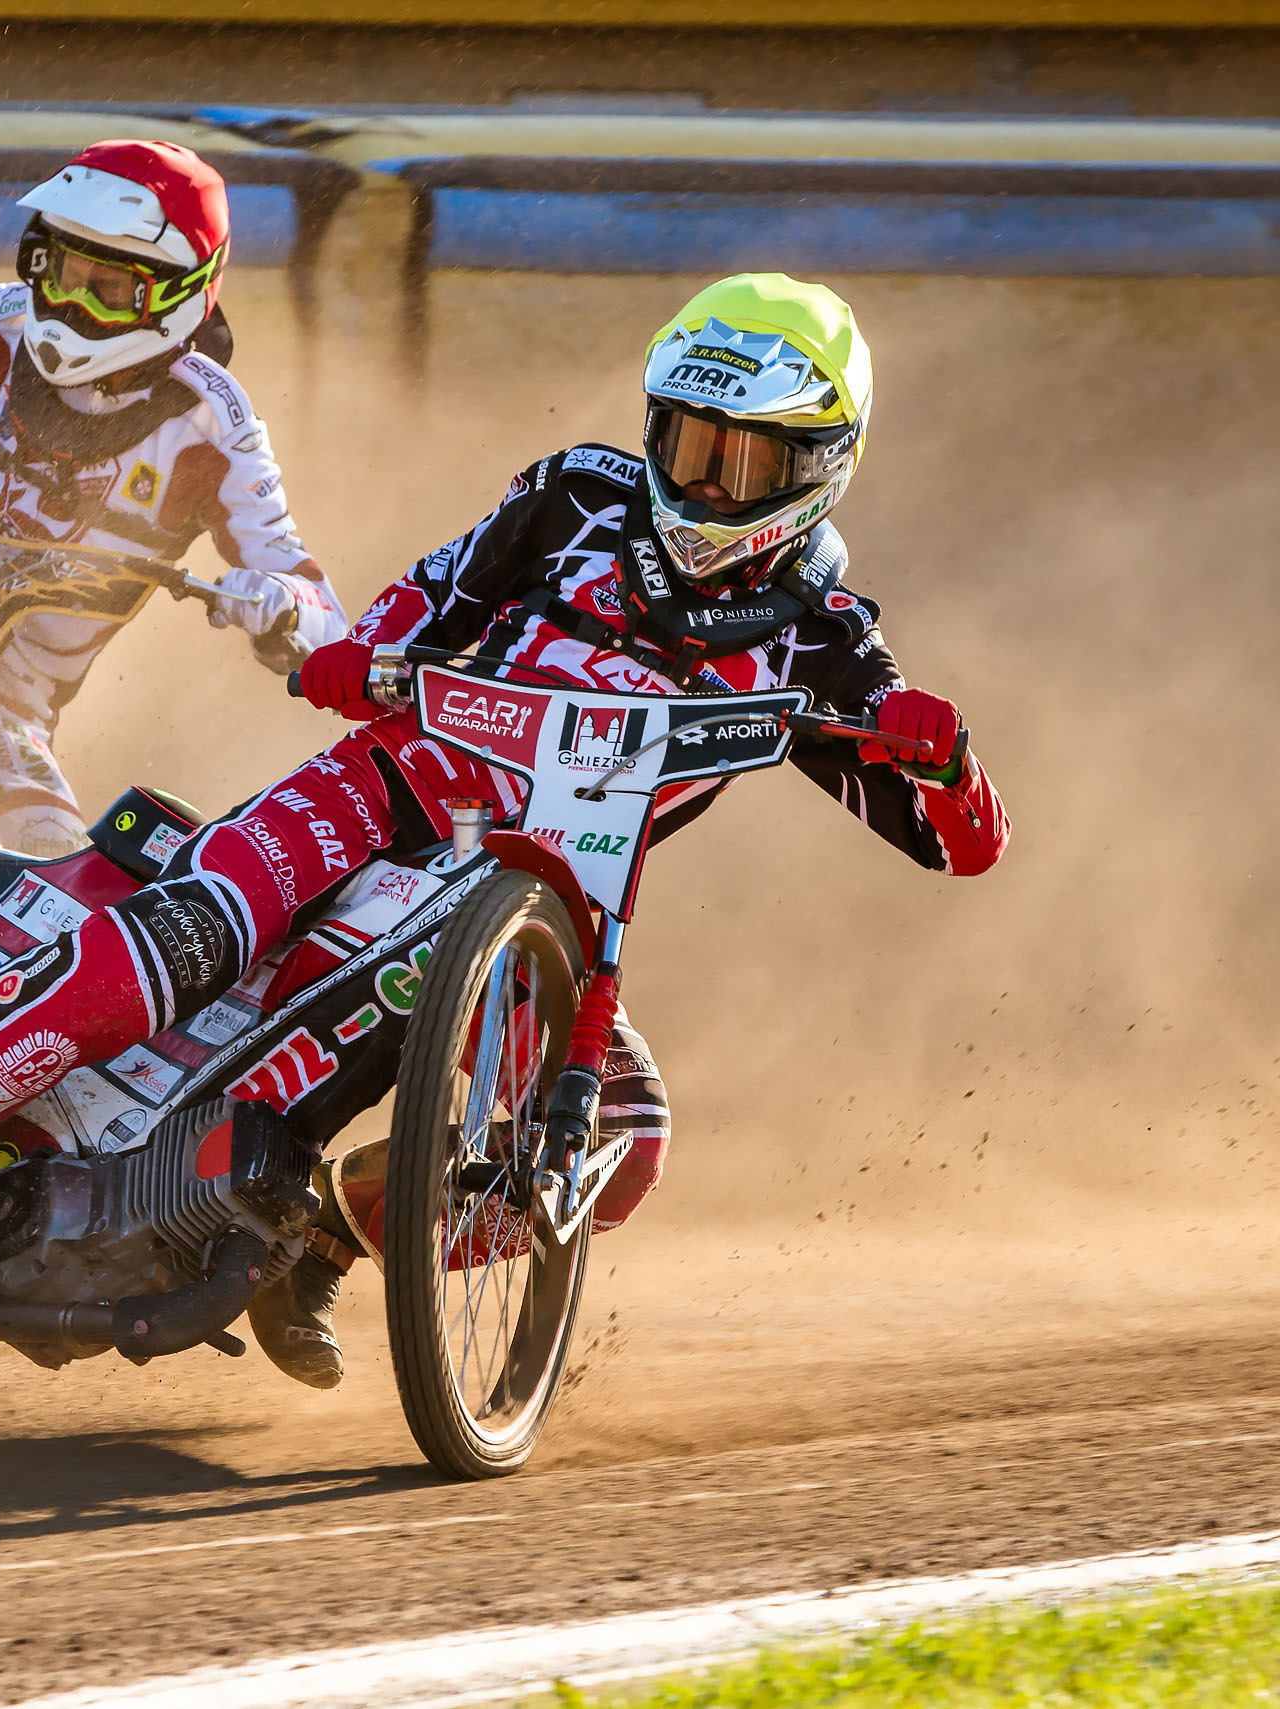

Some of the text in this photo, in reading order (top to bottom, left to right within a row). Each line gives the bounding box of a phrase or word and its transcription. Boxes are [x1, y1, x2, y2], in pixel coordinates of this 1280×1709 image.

[662, 380, 729, 400] PROJEKT
[667, 364, 740, 390] MAT
[752, 493, 831, 554] HIL-GAZ
[632, 540, 669, 599] KAPI
[712, 608, 774, 620] GNIEZNO
[443, 690, 519, 727] CAR
[438, 713, 512, 738] GWARANT
[715, 722, 778, 741] AFORTI
[558, 751, 637, 769] GNIEZNO
[339, 781, 382, 847] AFORTI
[271, 787, 349, 872] HIL-GAZ
[202, 922, 216, 943] POD
[25, 948, 58, 978] TOYOTA
[151, 916, 189, 986] CATERING
